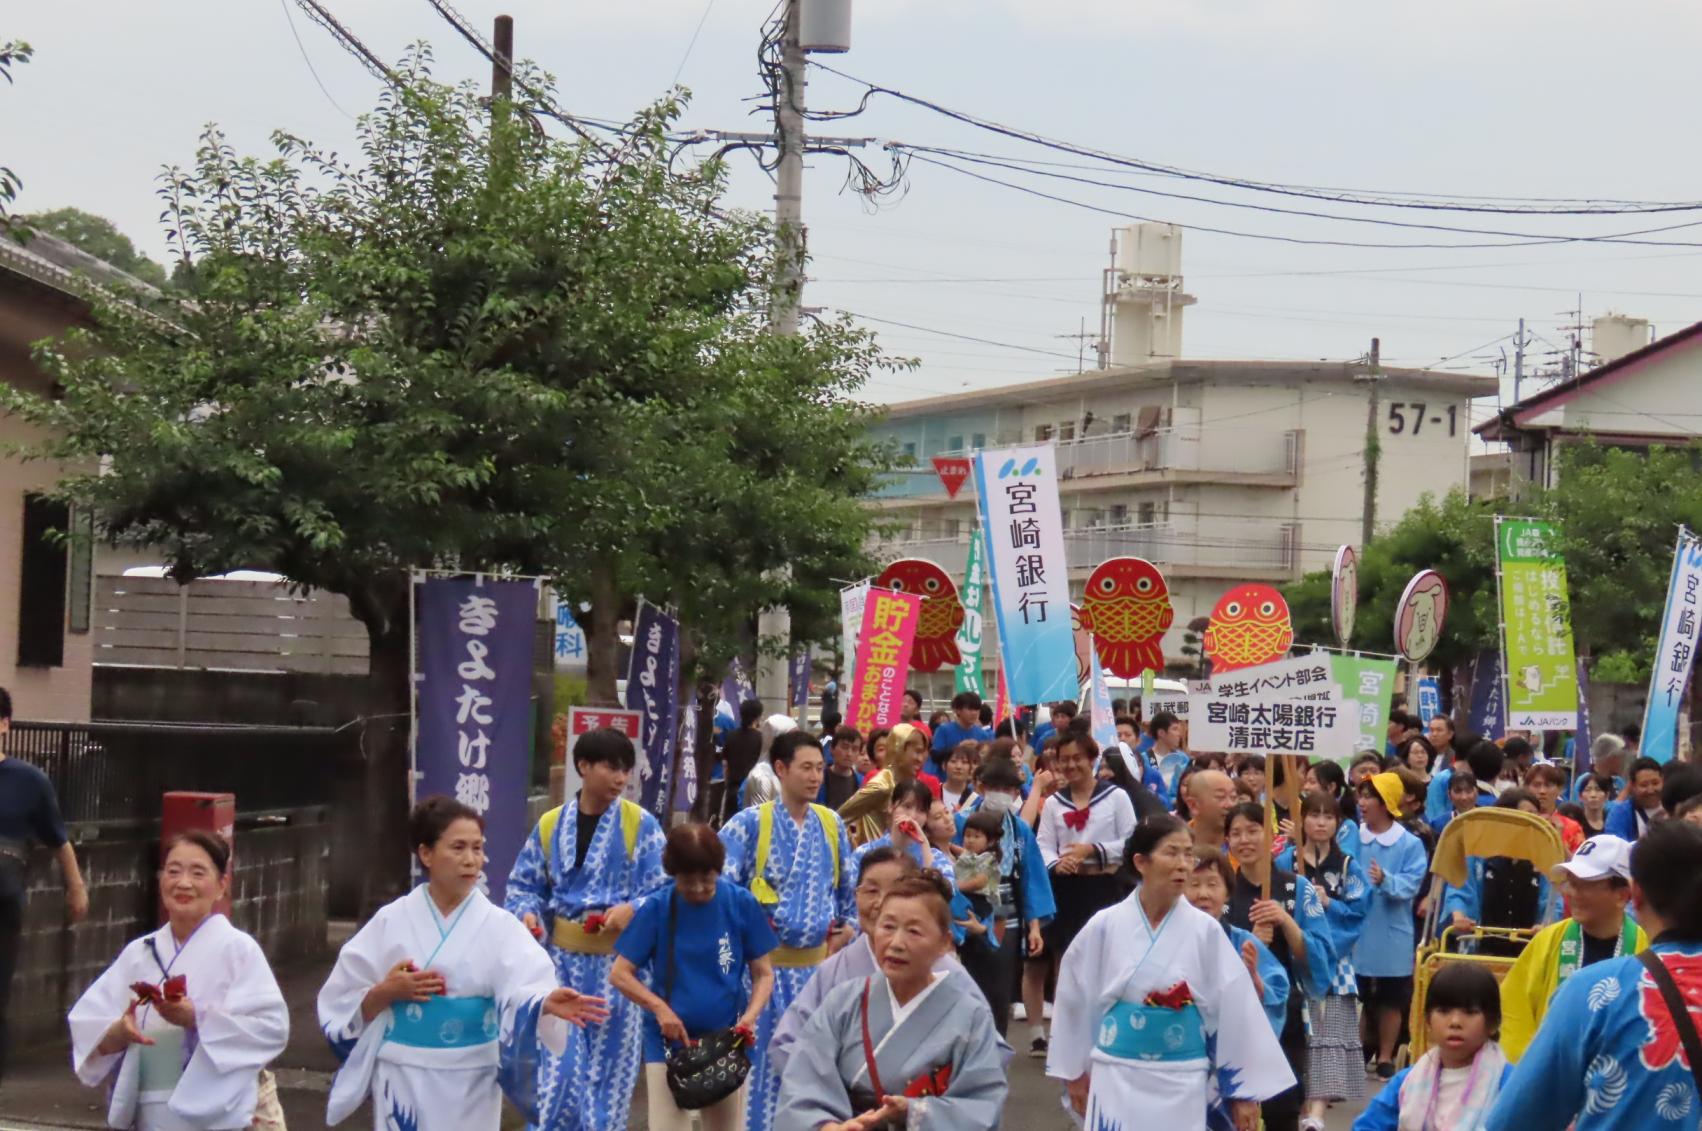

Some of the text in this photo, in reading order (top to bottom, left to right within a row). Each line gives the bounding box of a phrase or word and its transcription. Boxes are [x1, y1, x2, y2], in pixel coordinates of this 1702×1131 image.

[1389, 403, 1457, 437] 57-1
[1005, 481, 1049, 625] 宮崎銀行
[867, 596, 911, 666] 貯金
[1218, 666, 1328, 698] 学生イベント部会
[856, 666, 882, 738] おまかせ
[1207, 702, 1337, 728] 宮崎太陽銀行
[582, 714, 629, 732] 予告
[1538, 717, 1568, 727] JAバンク
[1228, 726, 1315, 751] 清武支店
